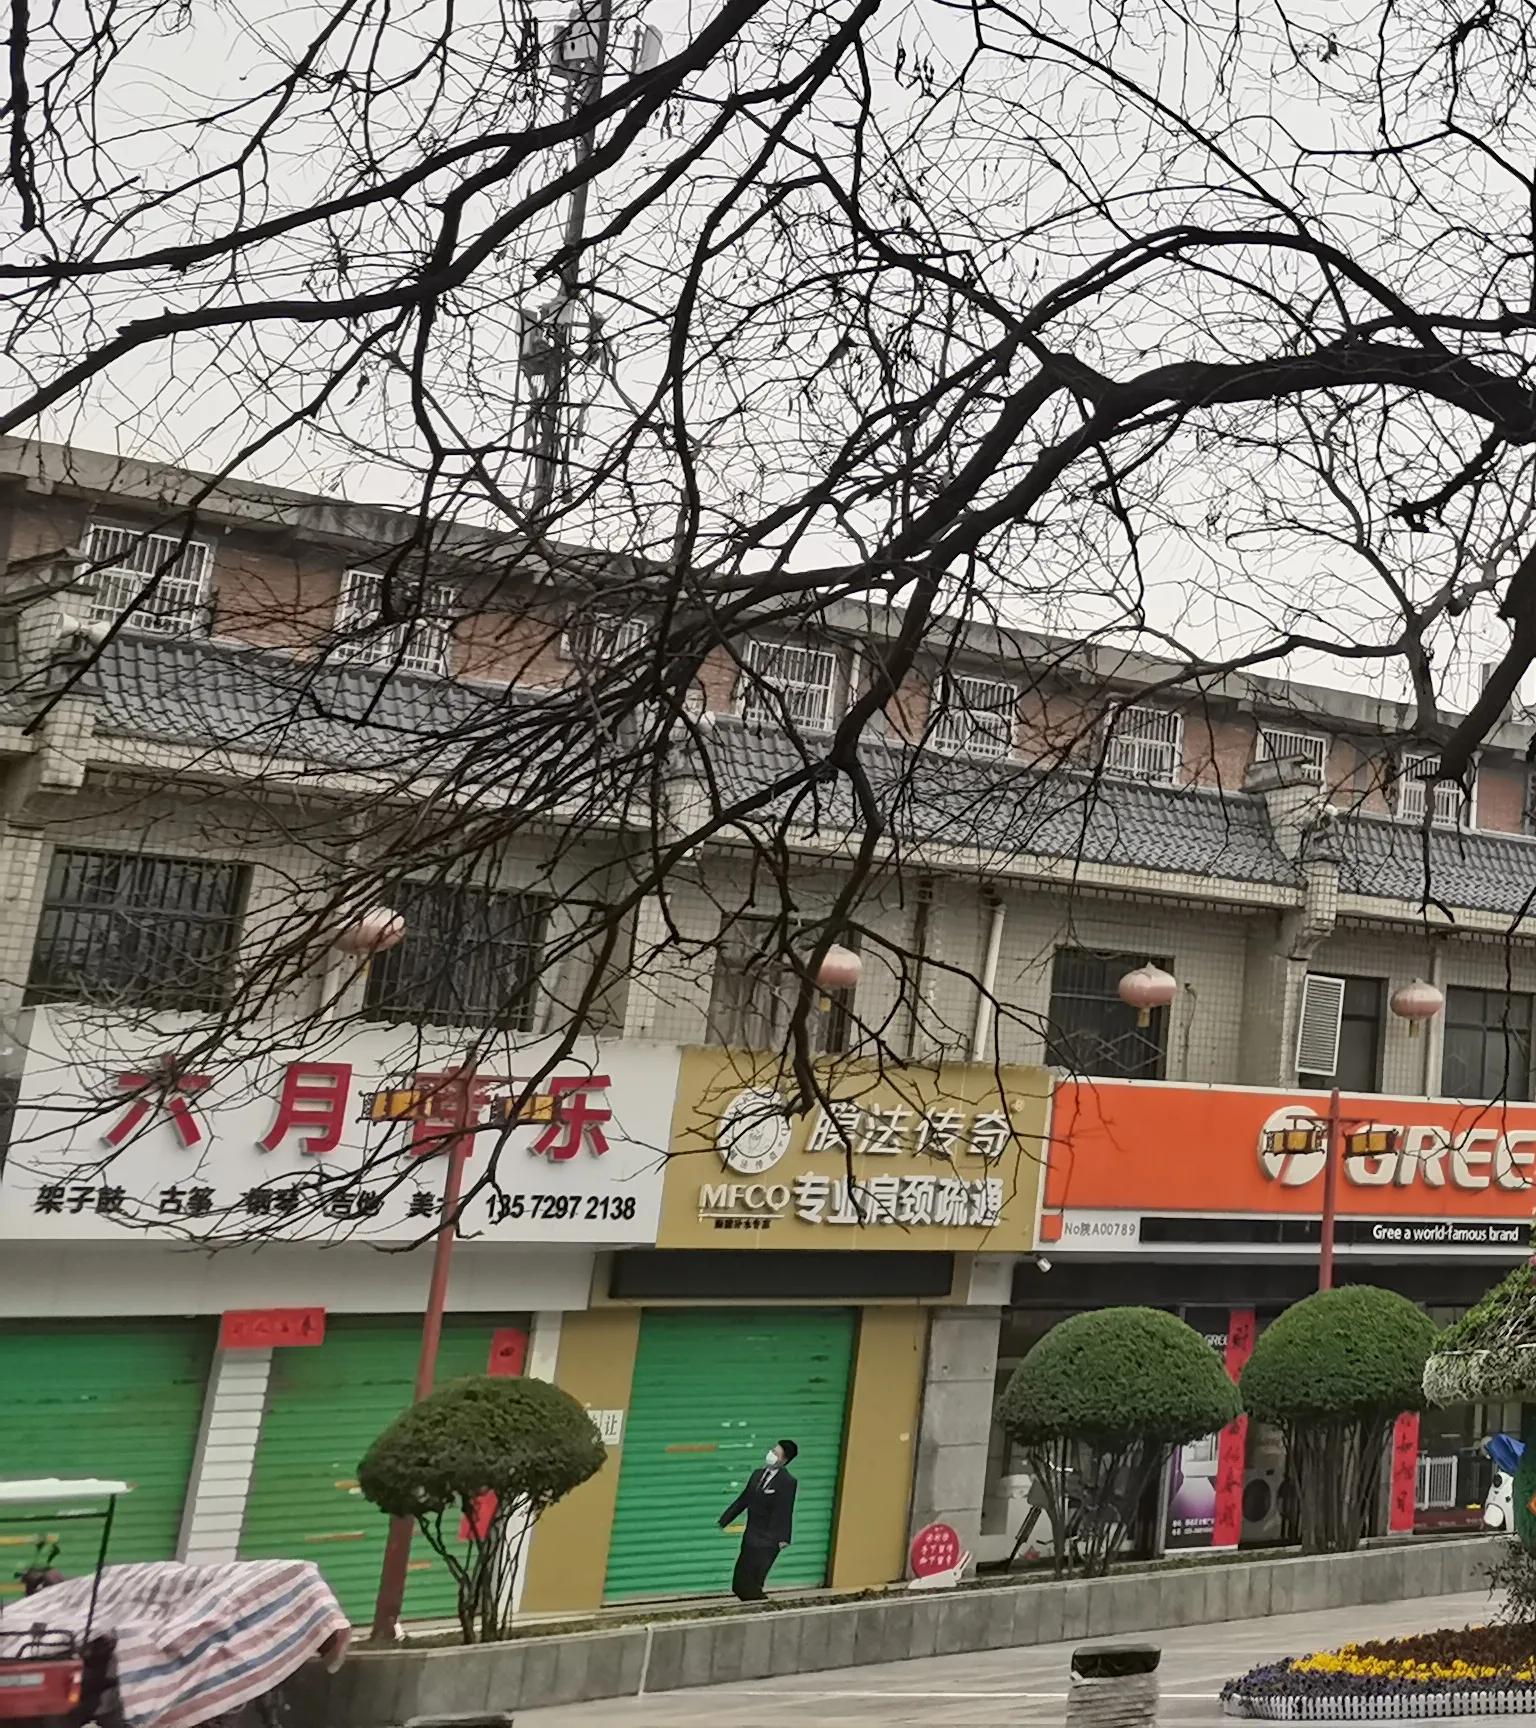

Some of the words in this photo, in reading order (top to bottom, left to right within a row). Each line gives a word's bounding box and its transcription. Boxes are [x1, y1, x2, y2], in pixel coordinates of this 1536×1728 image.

[35, 1185, 126, 1215] 架子鼓
[531, 1194, 583, 1220] 7297
[585, 1195, 637, 1221] 2138
[793, 1170, 1004, 1227] 专业肩颈疏通
[1372, 1224, 1401, 1241] Gree
[1404, 1228, 1411, 1241] a
[1413, 1224, 1487, 1242] world-famous
[1488, 1225, 1519, 1242] brand
